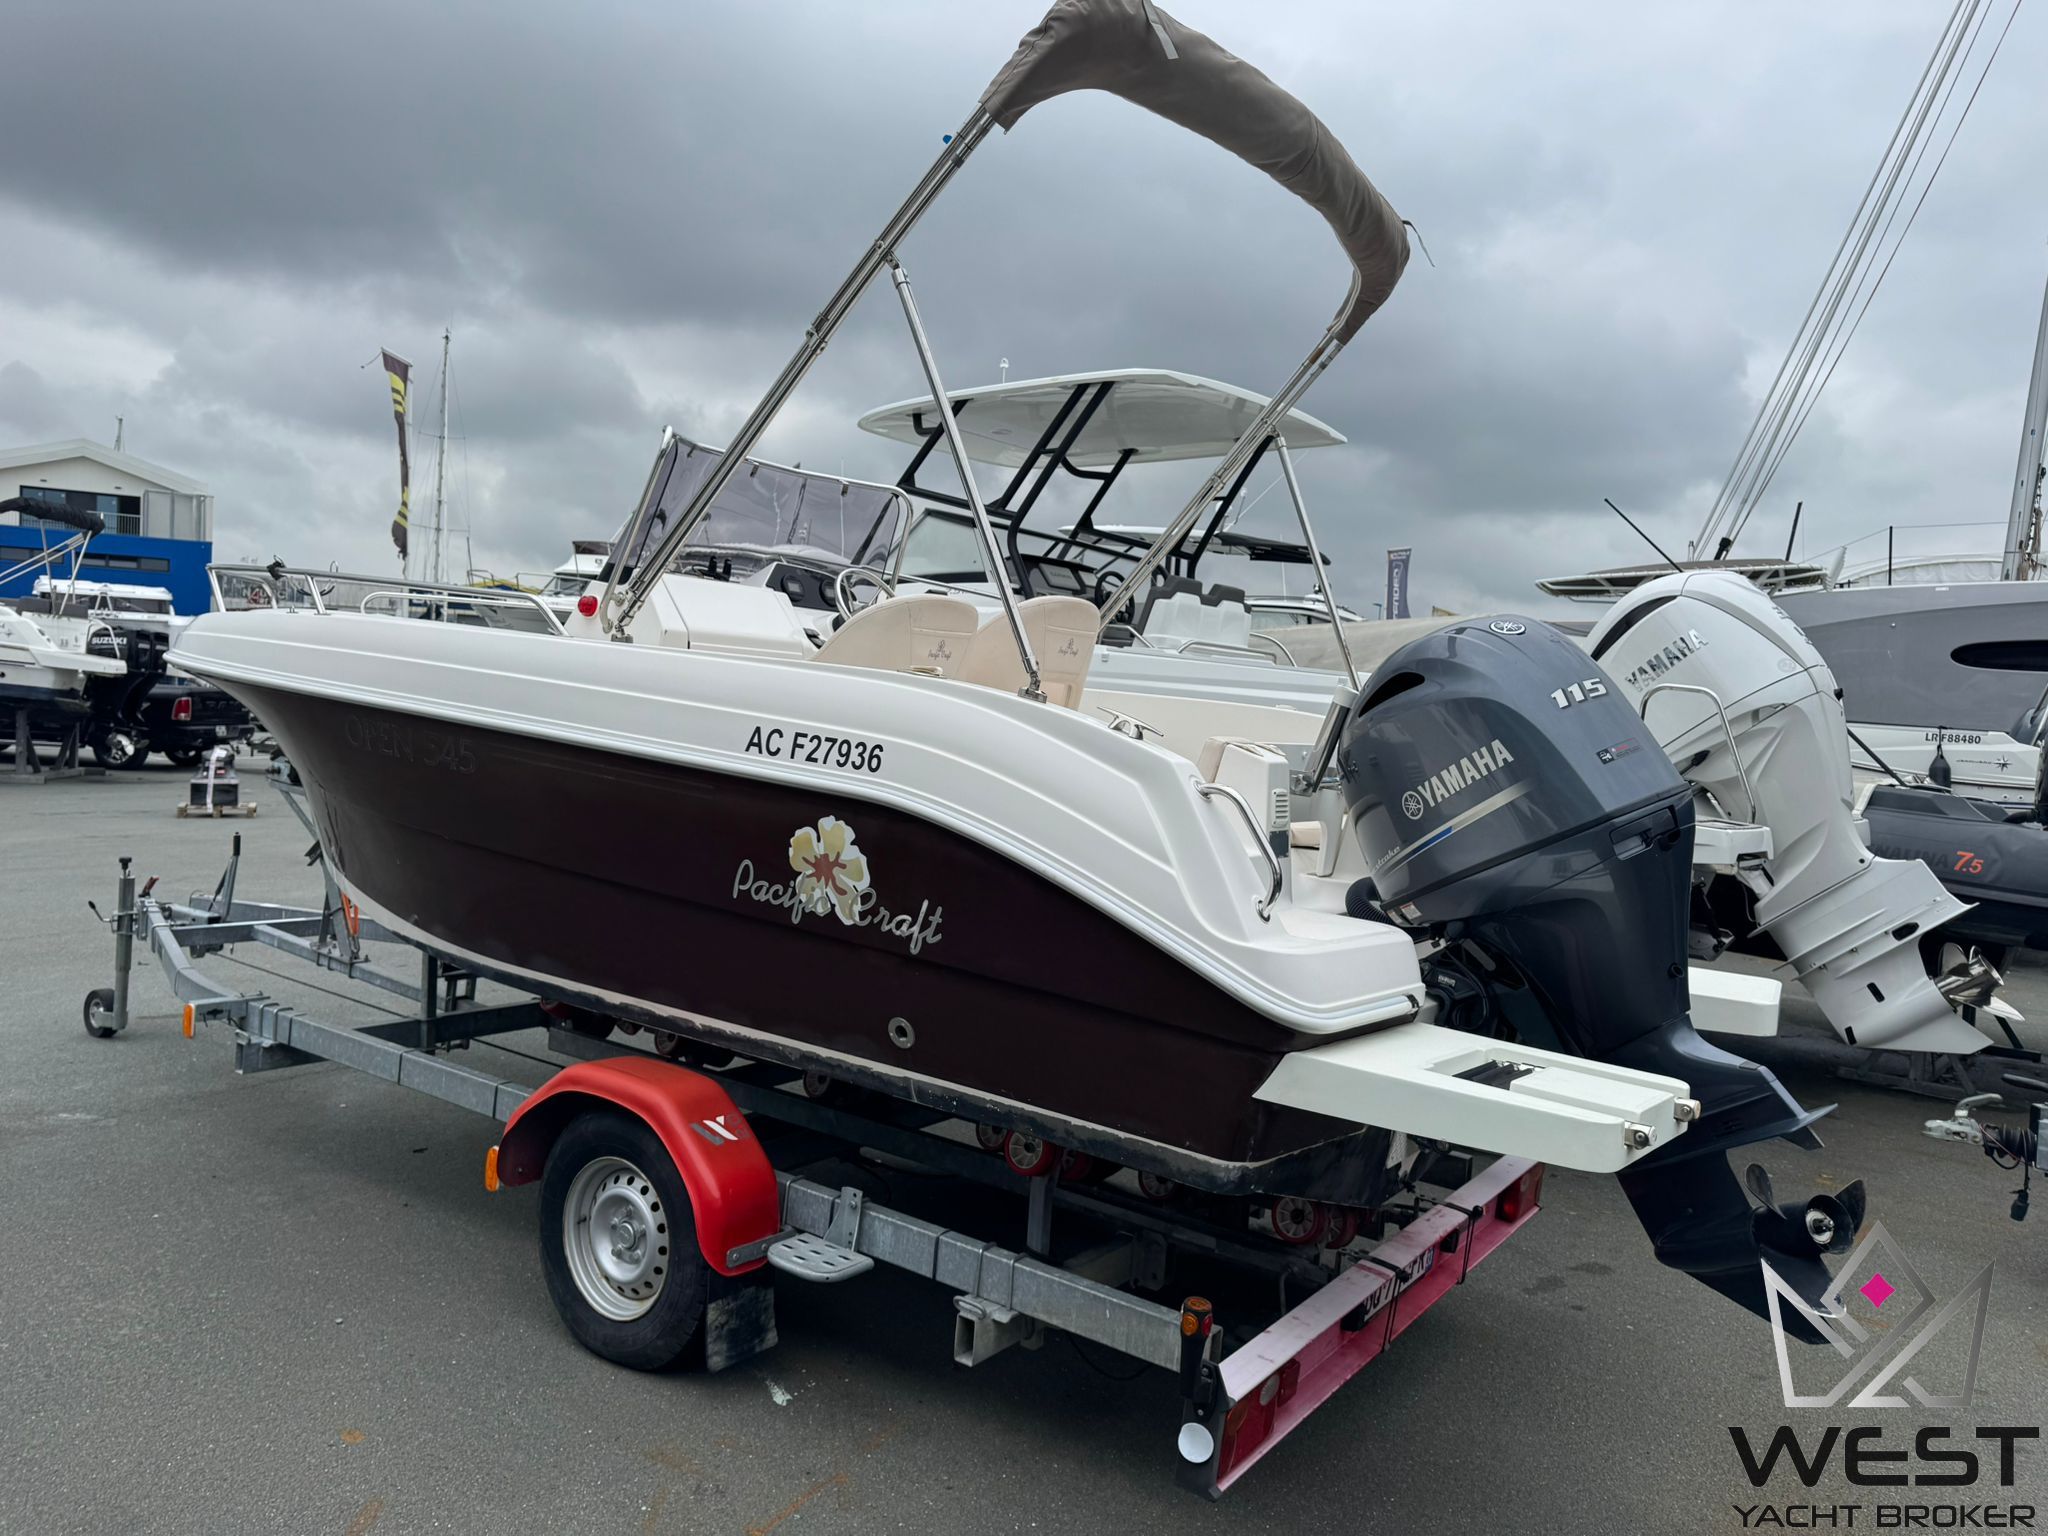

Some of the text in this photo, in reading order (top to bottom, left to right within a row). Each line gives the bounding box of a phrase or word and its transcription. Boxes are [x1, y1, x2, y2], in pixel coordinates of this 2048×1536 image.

[91, 637, 128, 645] SUZUKI
[1625, 628, 1709, 691] YAMAHA
[1550, 677, 1608, 710] 115
[744, 725, 884, 773] AC F27936
[1940, 733, 1981, 745] F88480
[1416, 738, 1515, 808] YAMAHA
[1953, 850, 1985, 874] 7.5
[733, 858, 943, 956] Pacific Craft
